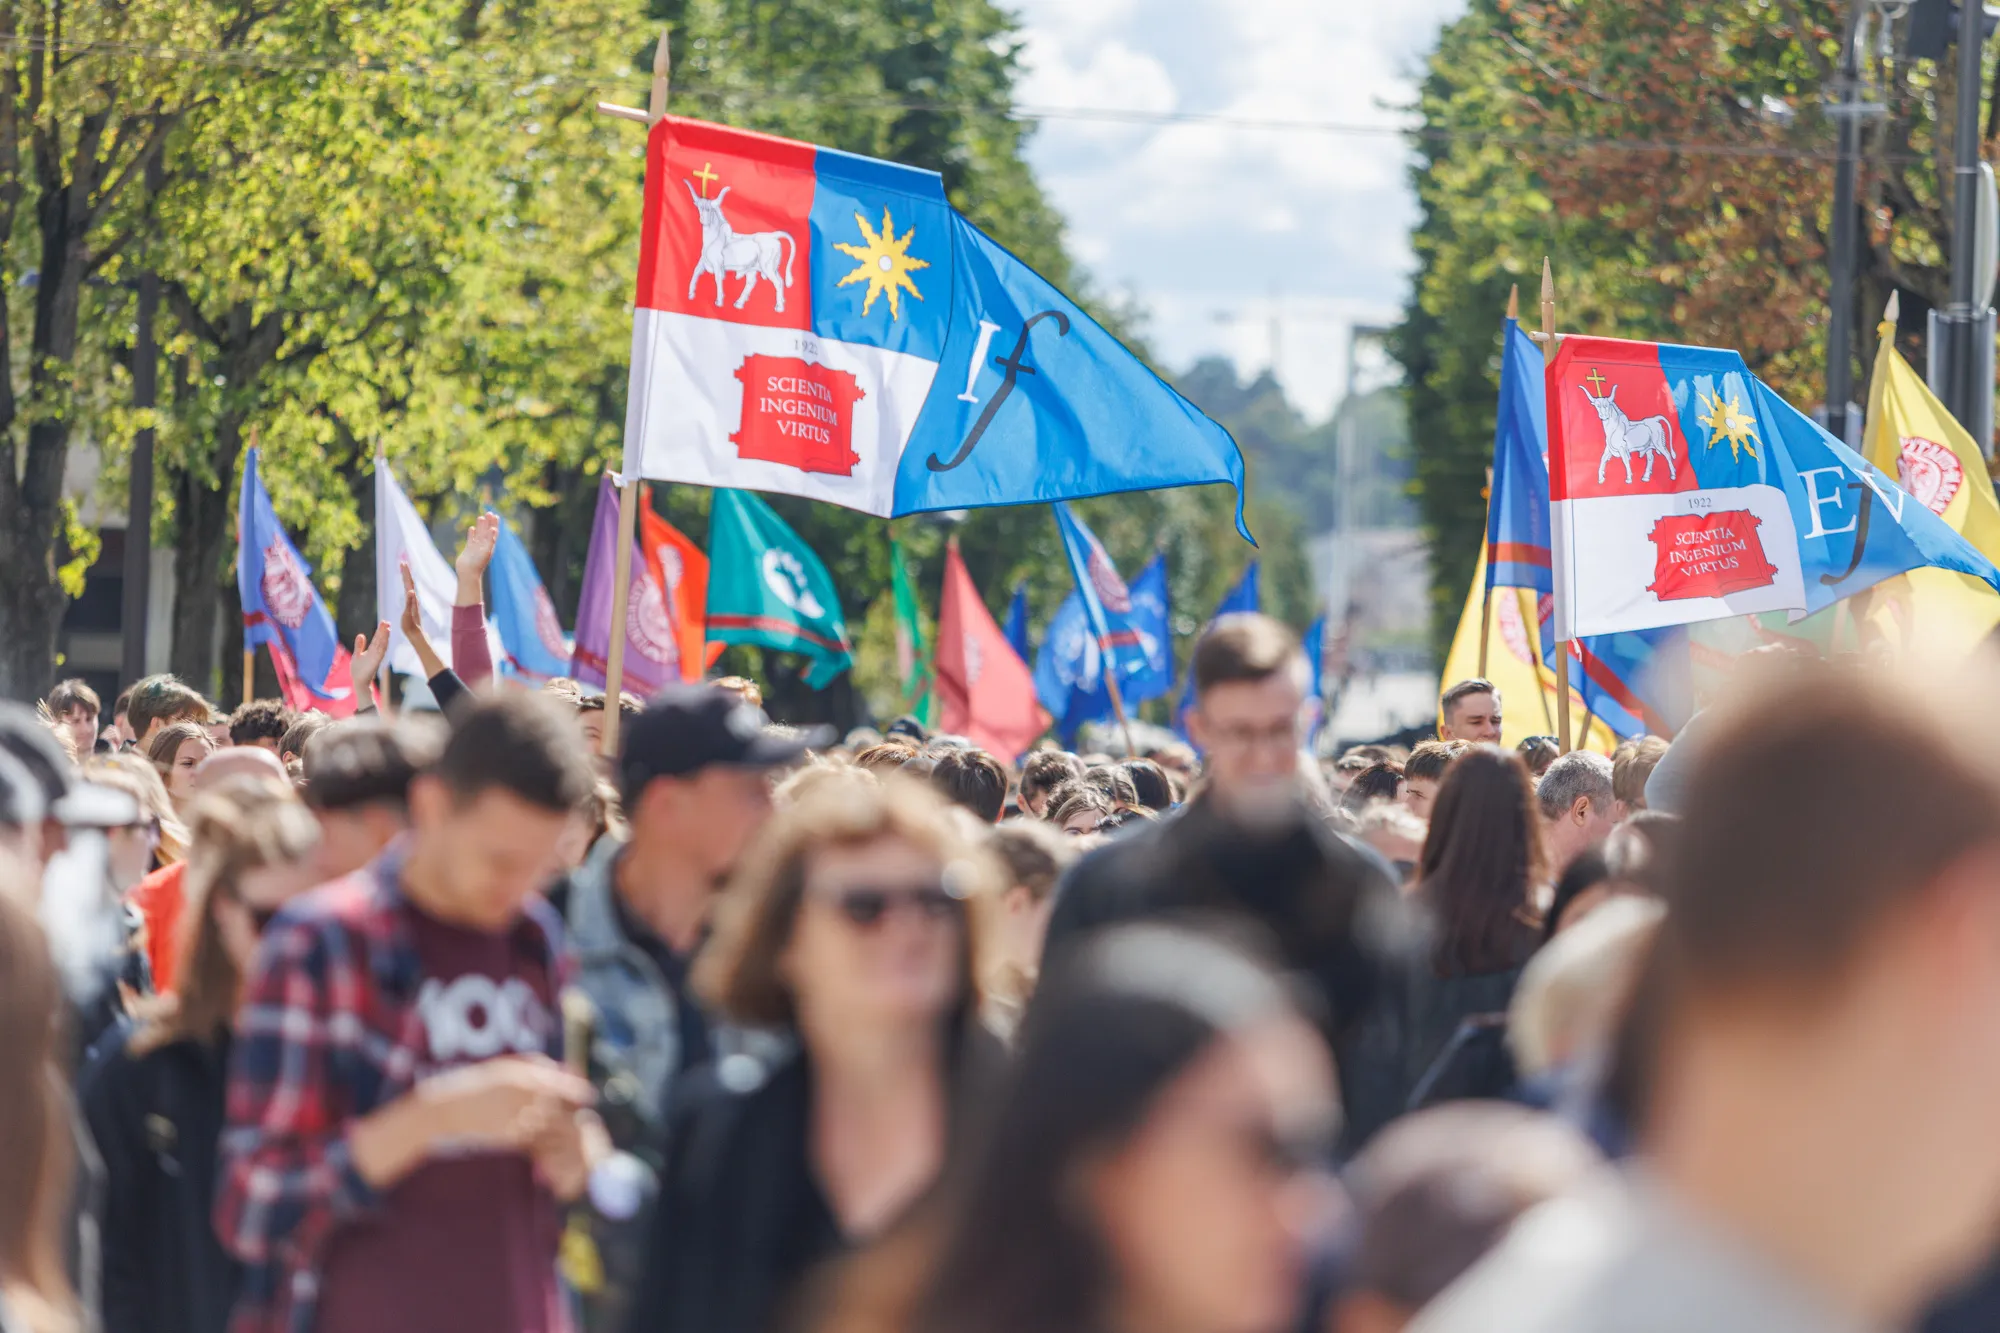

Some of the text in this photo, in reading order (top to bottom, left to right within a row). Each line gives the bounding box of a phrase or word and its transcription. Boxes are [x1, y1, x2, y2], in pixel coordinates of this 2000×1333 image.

[767, 376, 832, 404] SCIENTIA
[760, 397, 838, 426] INGENIUM
[776, 419, 830, 444] VIRTUS
[1688, 497, 1712, 509] 1922
[1675, 527, 1736, 546] SCIENTIA
[1669, 539, 1747, 564] INGENIUM
[1681, 556, 1739, 577] VIRTUS
